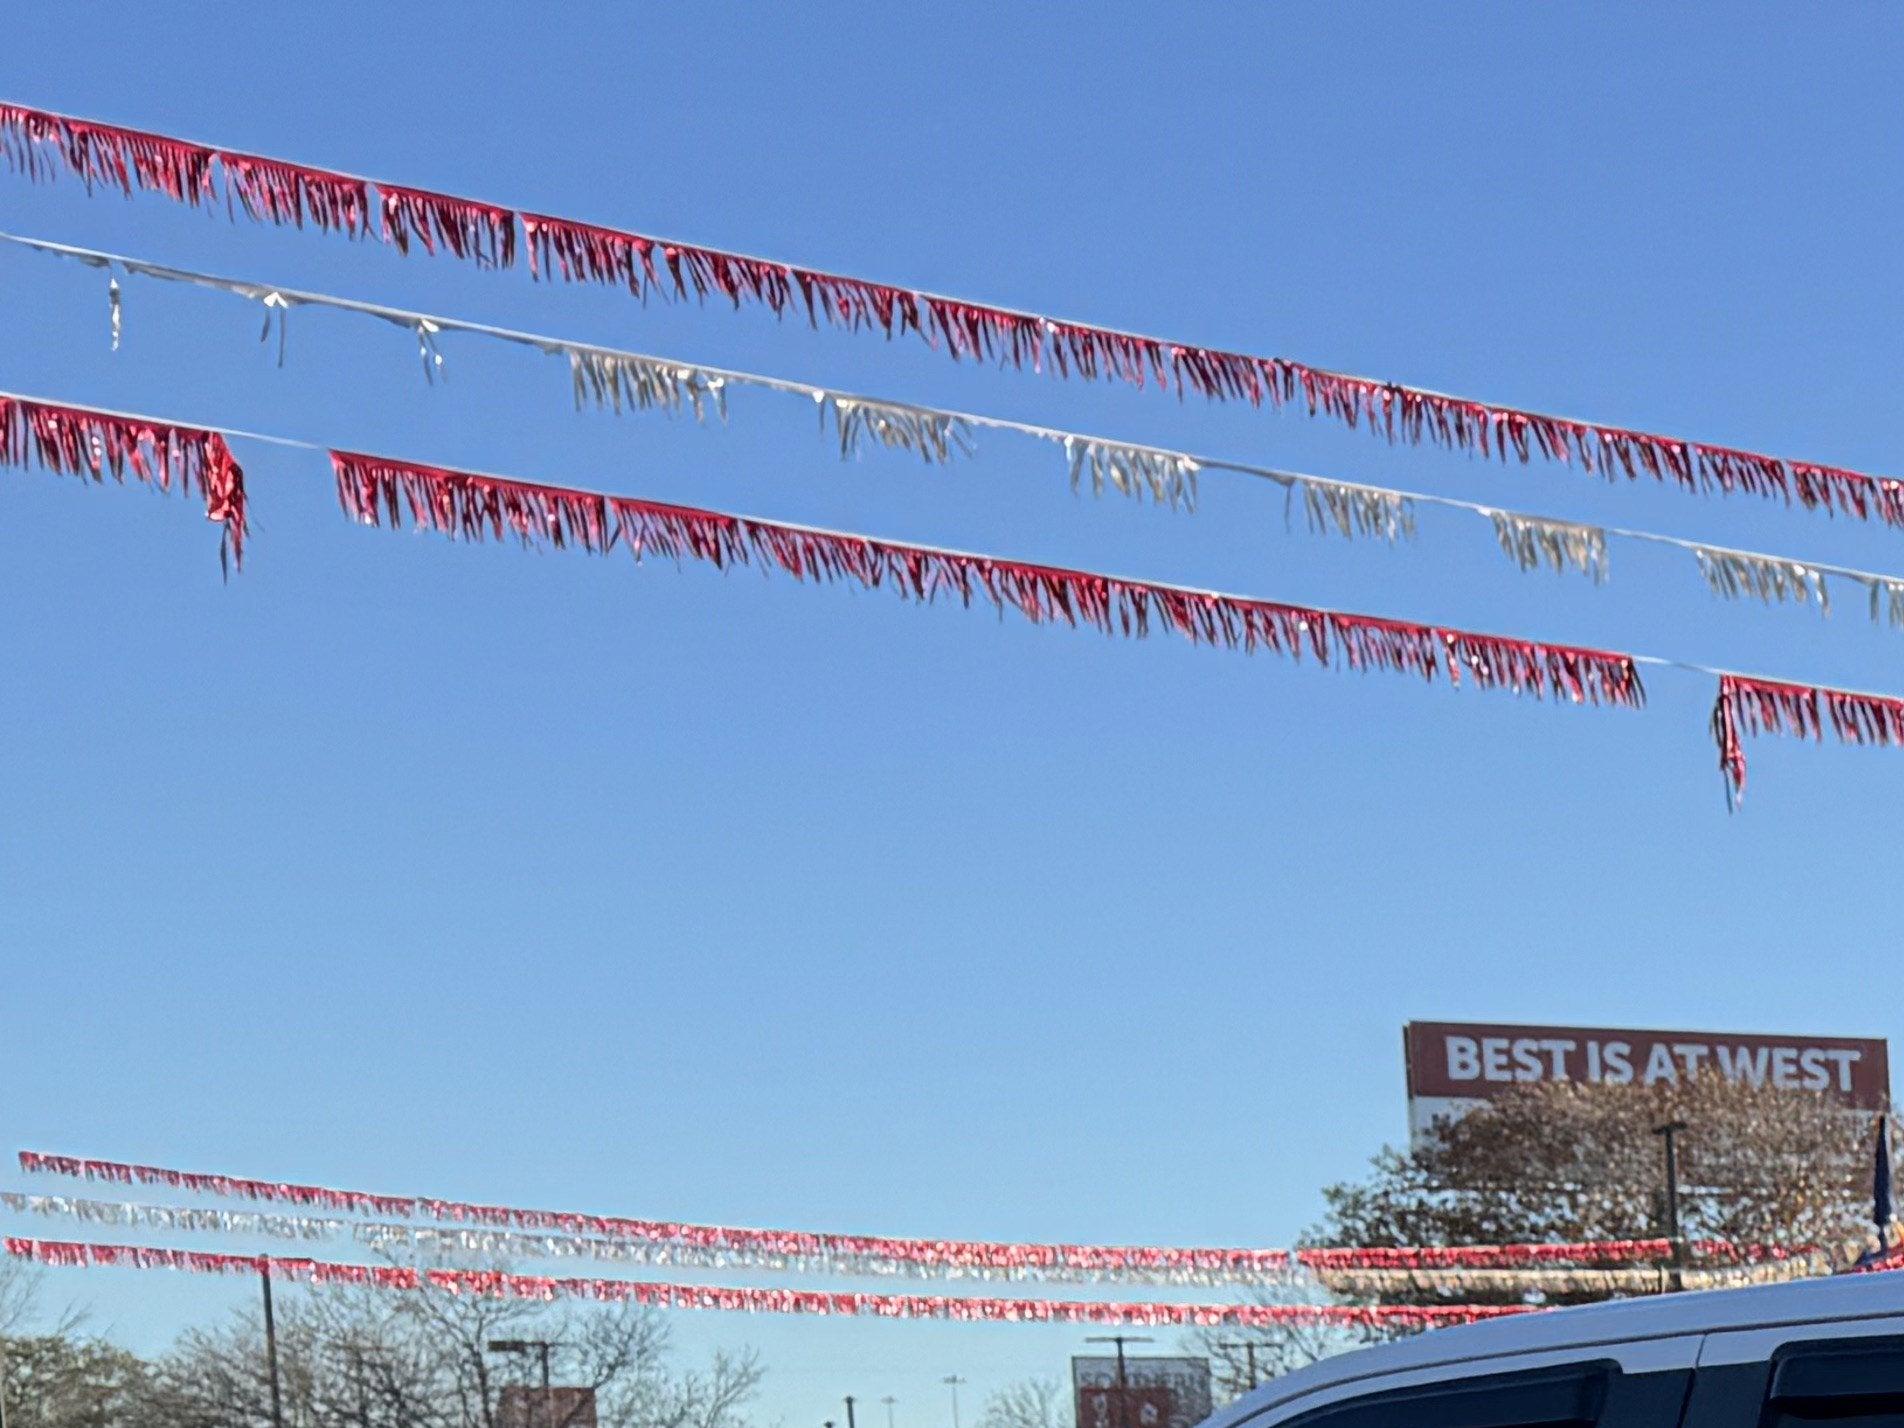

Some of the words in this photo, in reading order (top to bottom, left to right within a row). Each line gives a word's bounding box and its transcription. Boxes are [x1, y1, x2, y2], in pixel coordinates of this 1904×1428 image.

[1446, 1036, 1576, 1083] BEST
[1587, 1041, 1634, 1085] IS
[1645, 1042, 1709, 1086] AT
[1716, 1045, 1862, 1092] WEST
